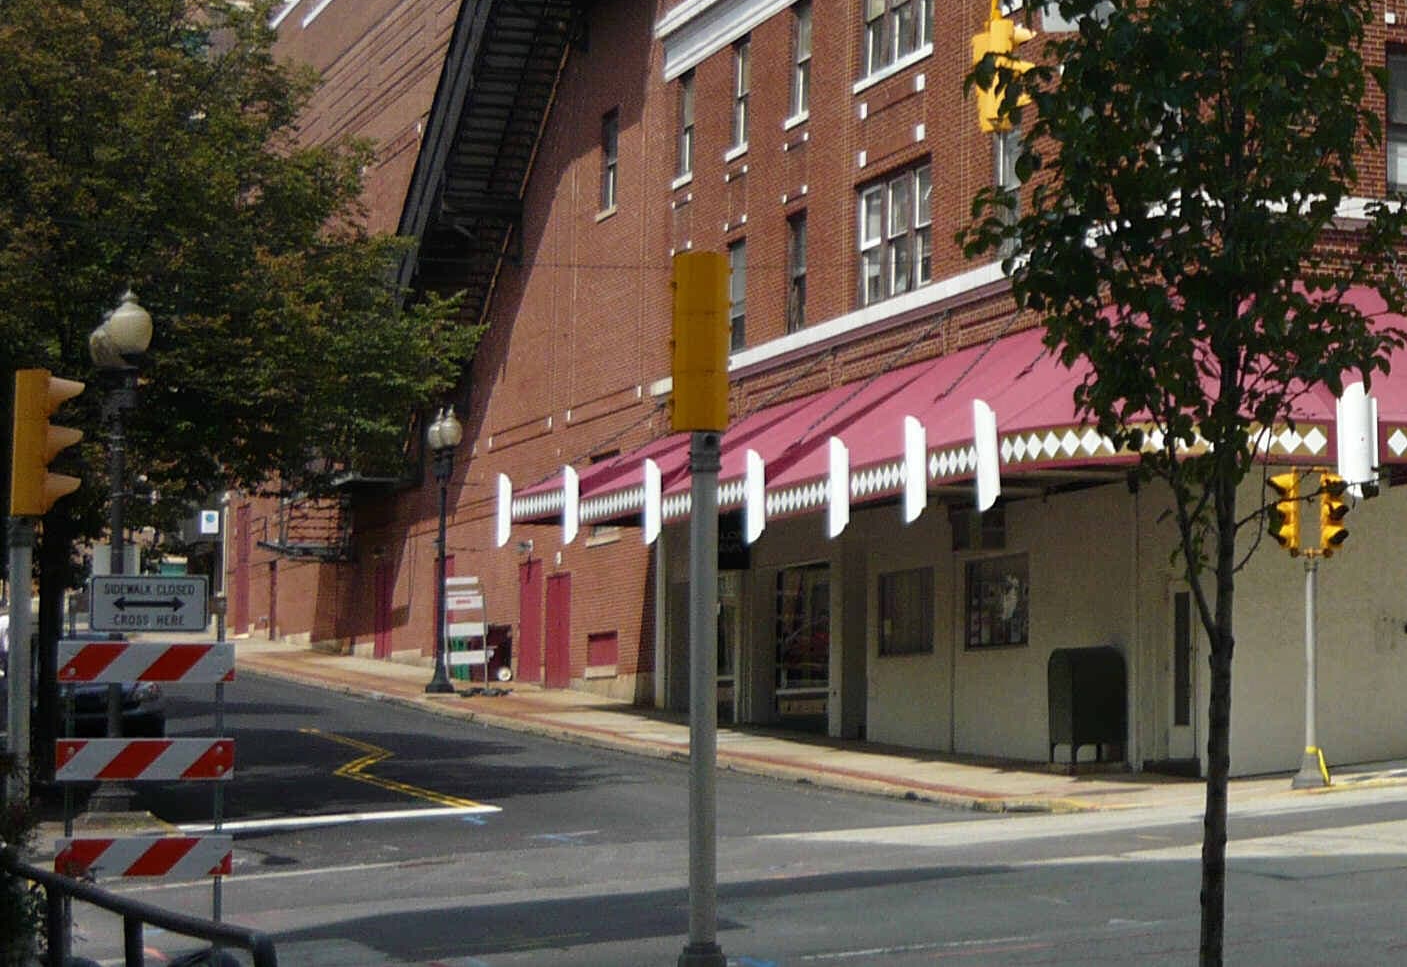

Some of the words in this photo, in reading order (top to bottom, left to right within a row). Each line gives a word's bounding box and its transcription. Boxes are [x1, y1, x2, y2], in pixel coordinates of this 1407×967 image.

[104, 583, 151, 595] SIDEWALK
[156, 583, 195, 595] CLOSED
[113, 614, 149, 626] CROSS
[156, 614, 185, 626] HERE
